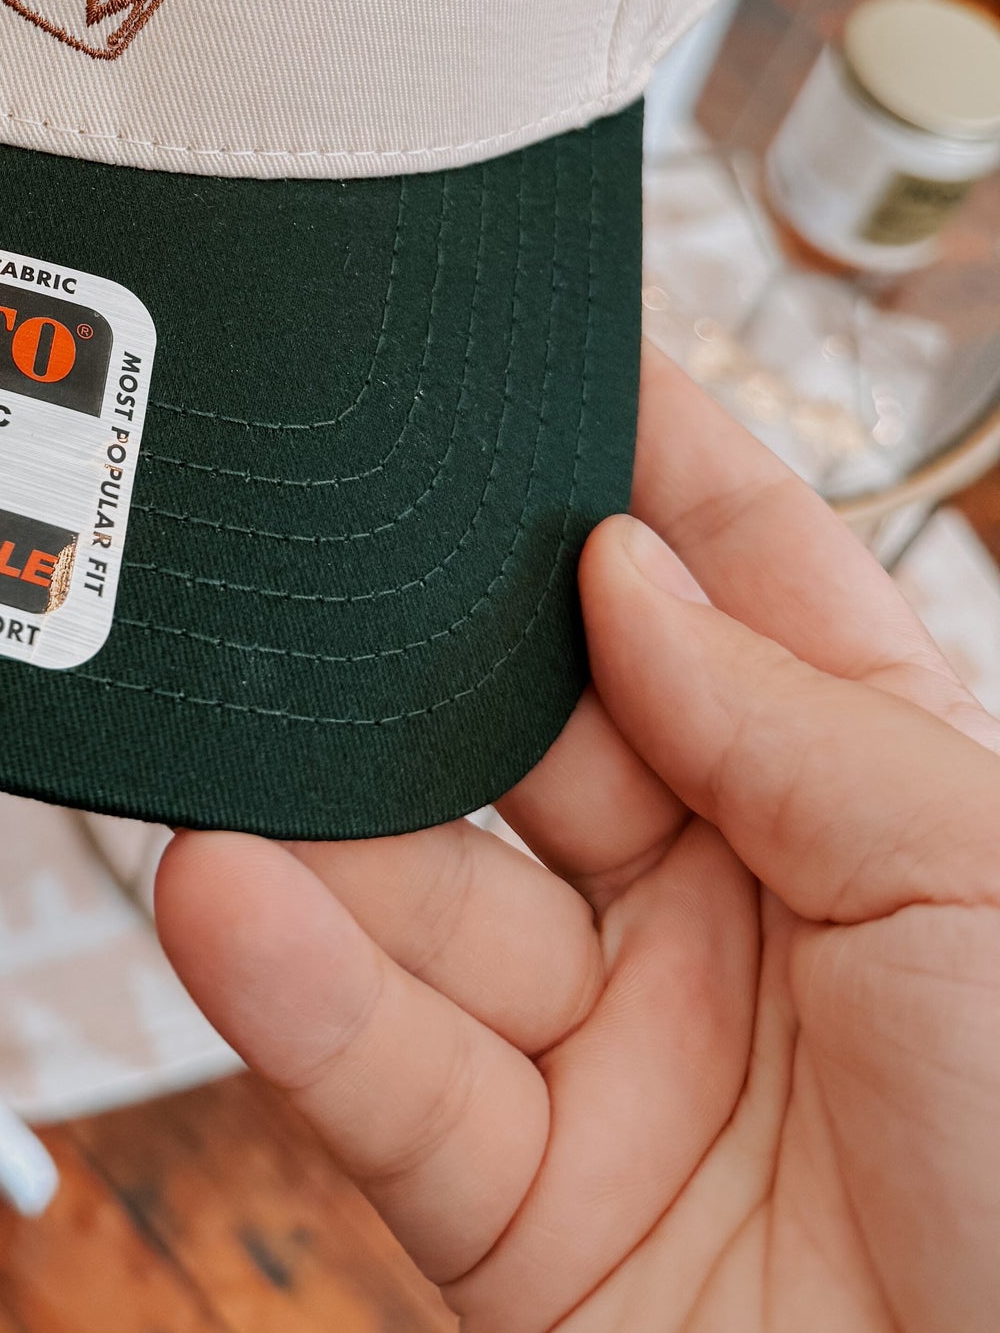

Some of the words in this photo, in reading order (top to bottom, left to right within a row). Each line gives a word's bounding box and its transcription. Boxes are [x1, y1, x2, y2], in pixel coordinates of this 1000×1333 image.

[112, 351, 143, 422] MOST
[92, 426, 130, 550] POPULAR
[84, 556, 109, 598] FIT
